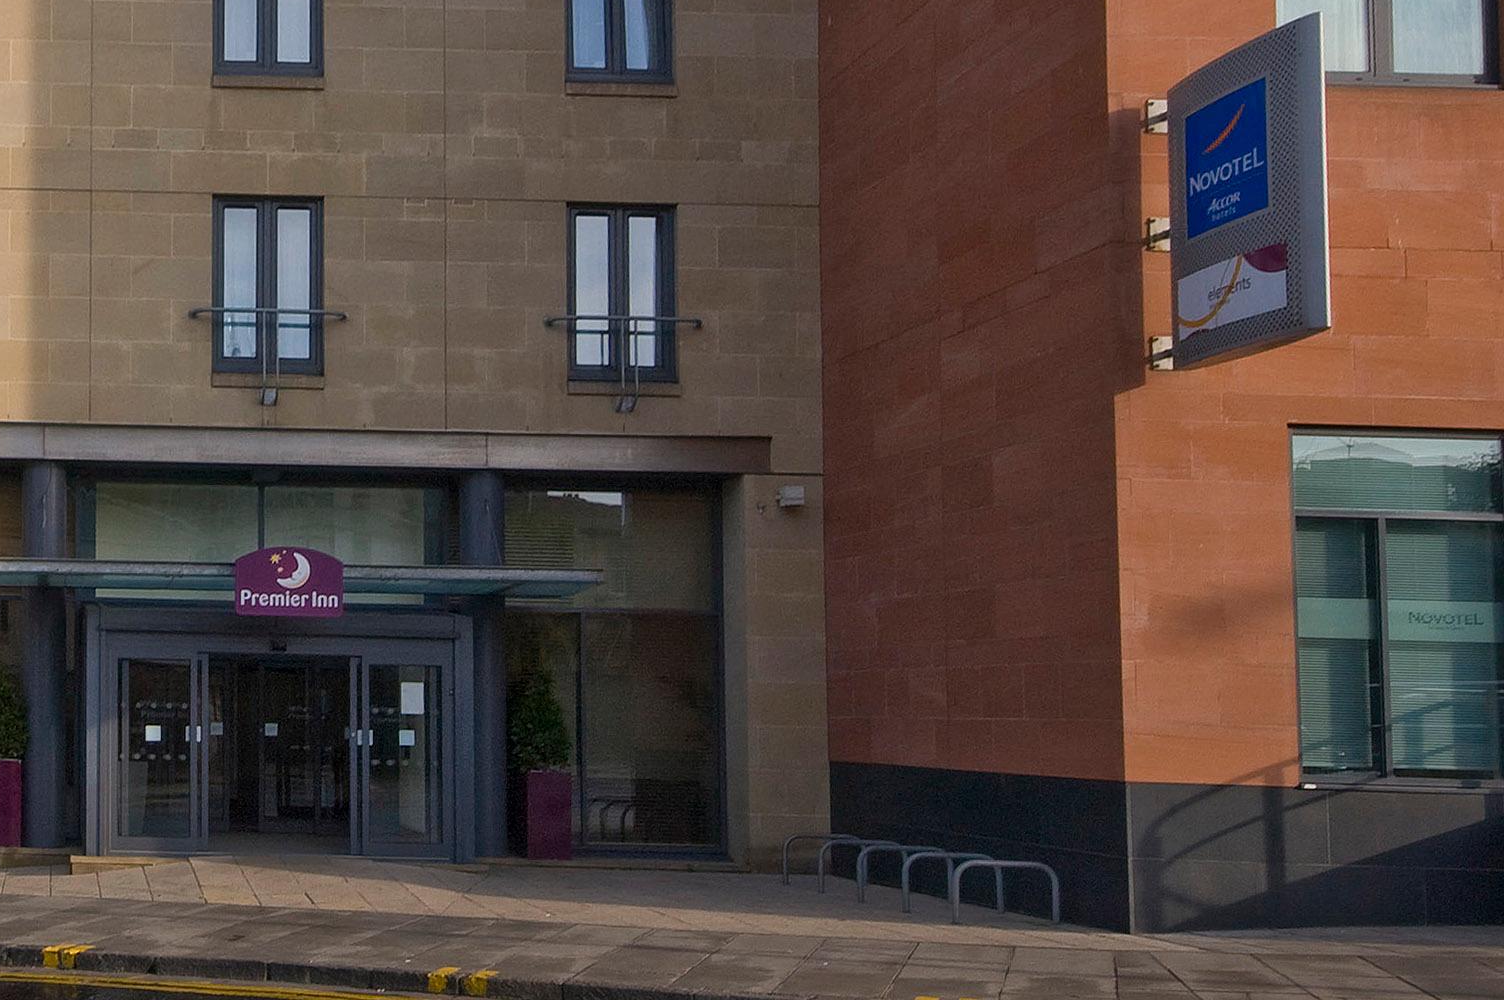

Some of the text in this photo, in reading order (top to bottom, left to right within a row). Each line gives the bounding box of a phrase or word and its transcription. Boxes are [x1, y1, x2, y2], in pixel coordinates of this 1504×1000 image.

[1189, 147, 1264, 196] NOVOTEL
[240, 590, 339, 608] Premier Inn
[1408, 611, 1484, 625] NOVOTEL
